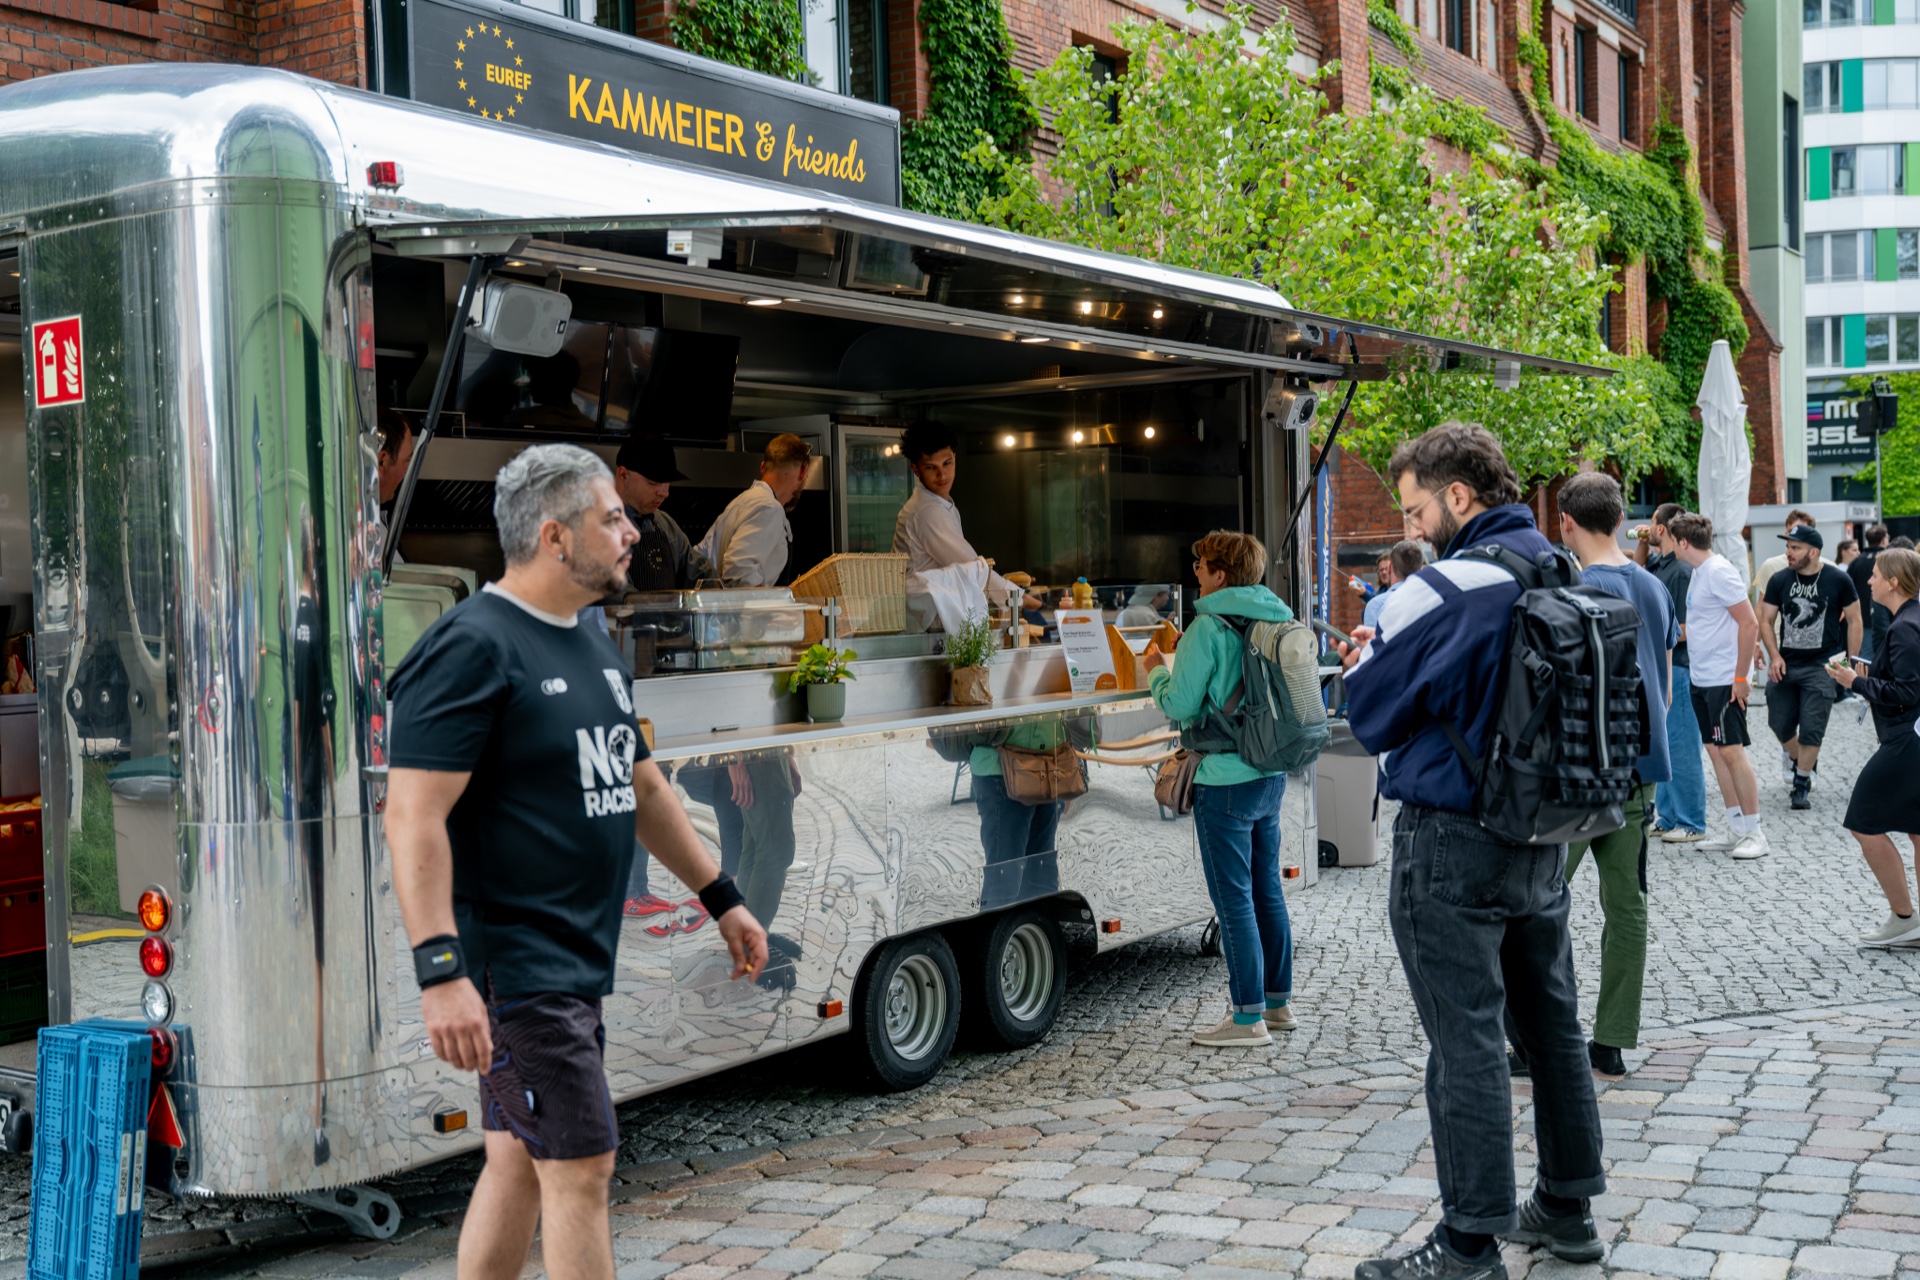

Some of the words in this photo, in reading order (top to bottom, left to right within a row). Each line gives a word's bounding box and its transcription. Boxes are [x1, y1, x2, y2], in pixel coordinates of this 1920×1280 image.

[486, 63, 532, 91] EUREF
[569, 73, 748, 158] KAMMEIER
[755, 121, 776, 162] &
[783, 123, 867, 183] friends
[1789, 581, 1819, 599] GOJIRA
[583, 784, 637, 818] RACIS
